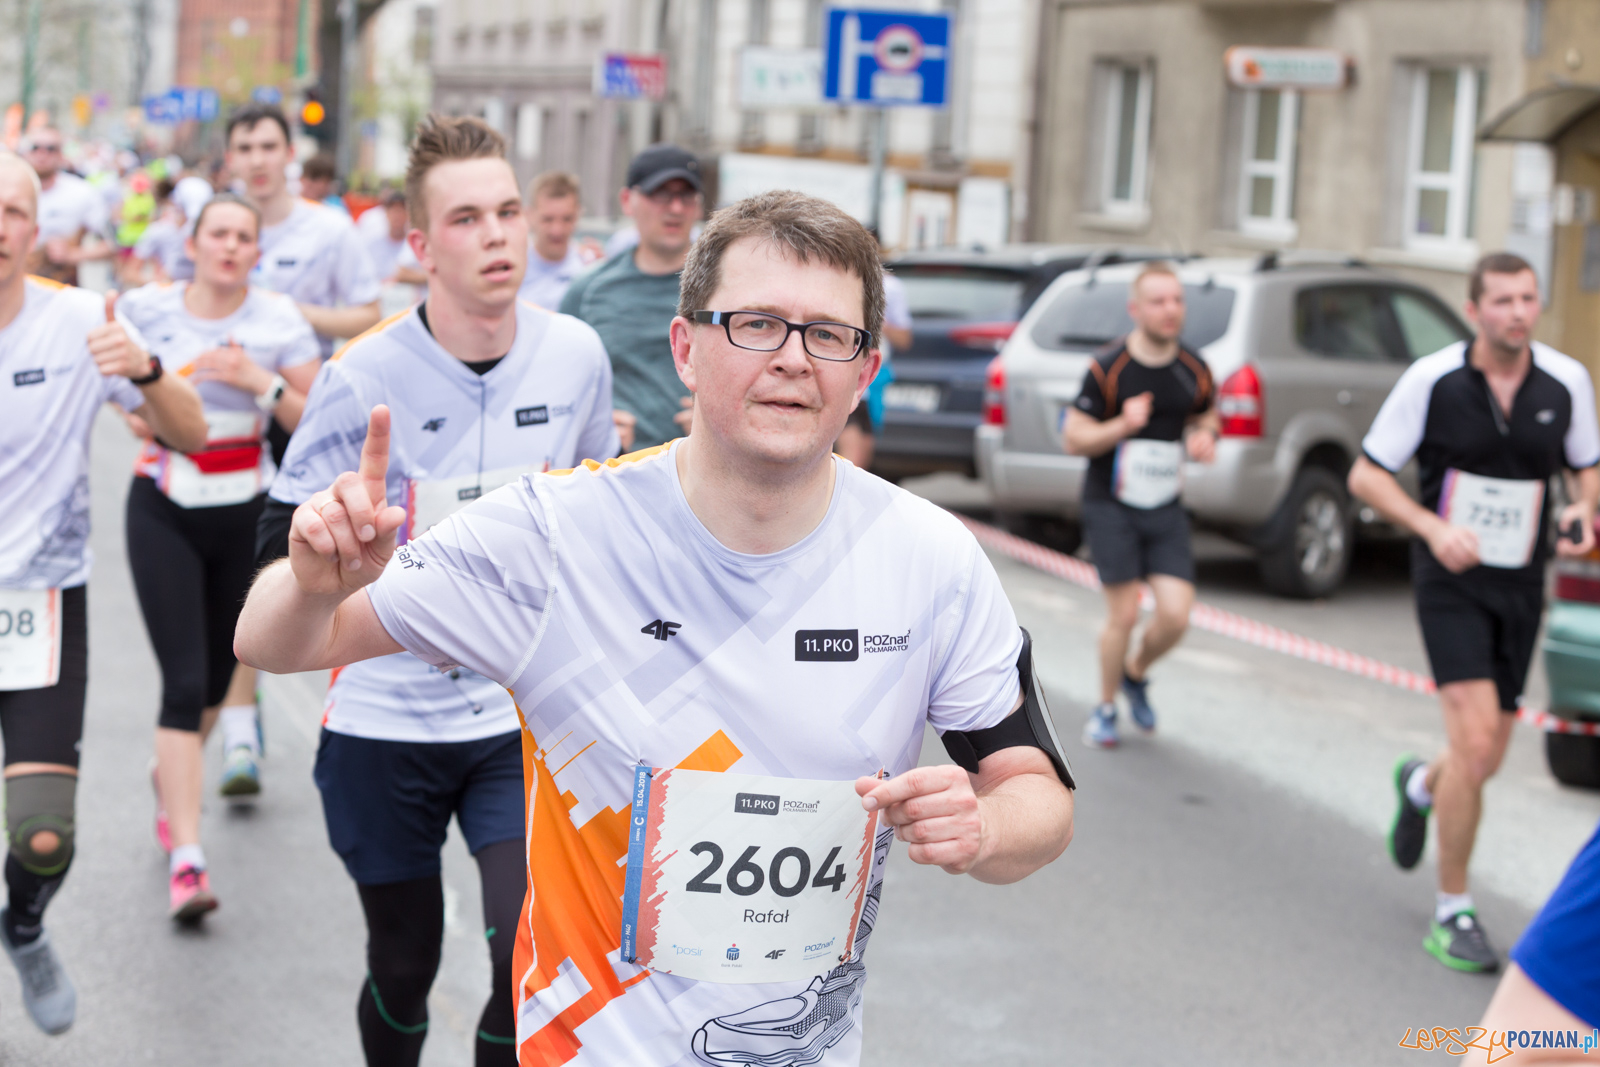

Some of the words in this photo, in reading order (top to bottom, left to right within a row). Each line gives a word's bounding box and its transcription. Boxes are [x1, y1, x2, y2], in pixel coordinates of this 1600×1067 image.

[641, 619, 682, 641] 4F
[803, 638, 821, 652] 11.
[823, 638, 853, 652] PKO
[636, 771, 647, 807] 15.04.2018
[741, 798, 753, 808] 11.
[754, 800, 776, 810] PKO
[634, 816, 645, 826] C
[686, 841, 846, 897] 2604
[743, 909, 789, 923] Rafał
[764, 949, 786, 959] 4F
